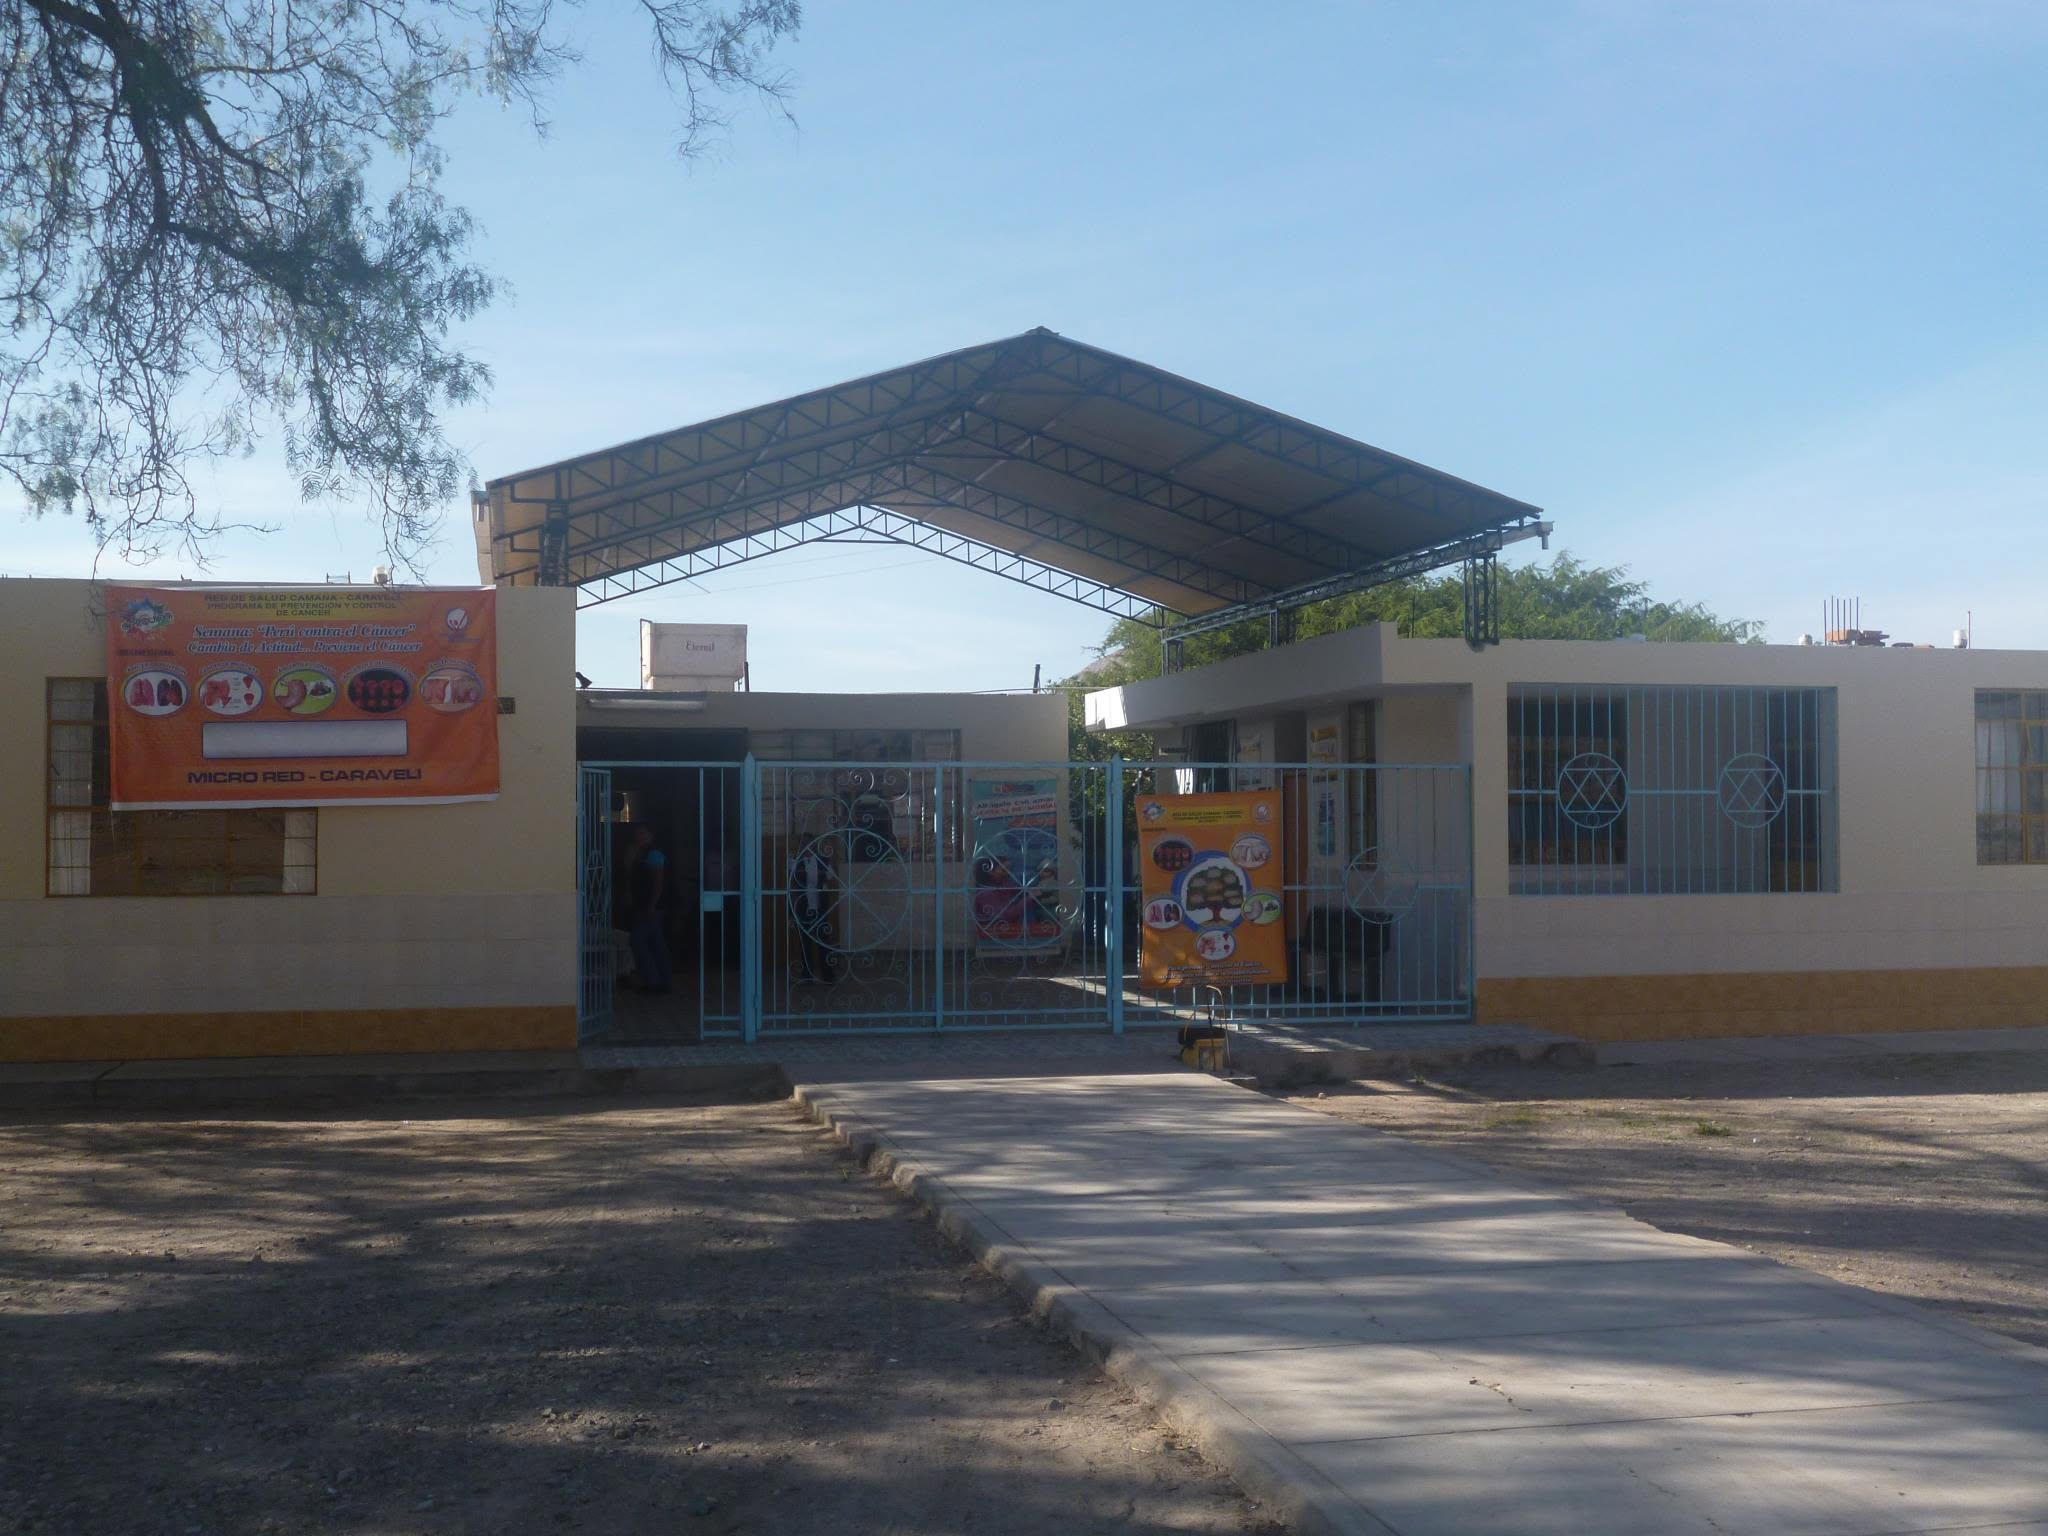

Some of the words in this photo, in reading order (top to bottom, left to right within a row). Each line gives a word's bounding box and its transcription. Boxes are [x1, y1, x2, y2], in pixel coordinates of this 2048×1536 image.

[205, 594, 228, 602] RED
[231, 594, 246, 602] DE
[249, 594, 286, 602] SALUD
[276, 609, 289, 617] DE
[297, 626, 343, 639] contra
[344, 624, 357, 639] el
[187, 640, 238, 655] Cambio
[239, 640, 254, 655] de
[365, 640, 377, 653] el
[187, 771, 258, 783] MICRO
[262, 771, 304, 782] RED
[320, 768, 421, 781] CARAVELI
